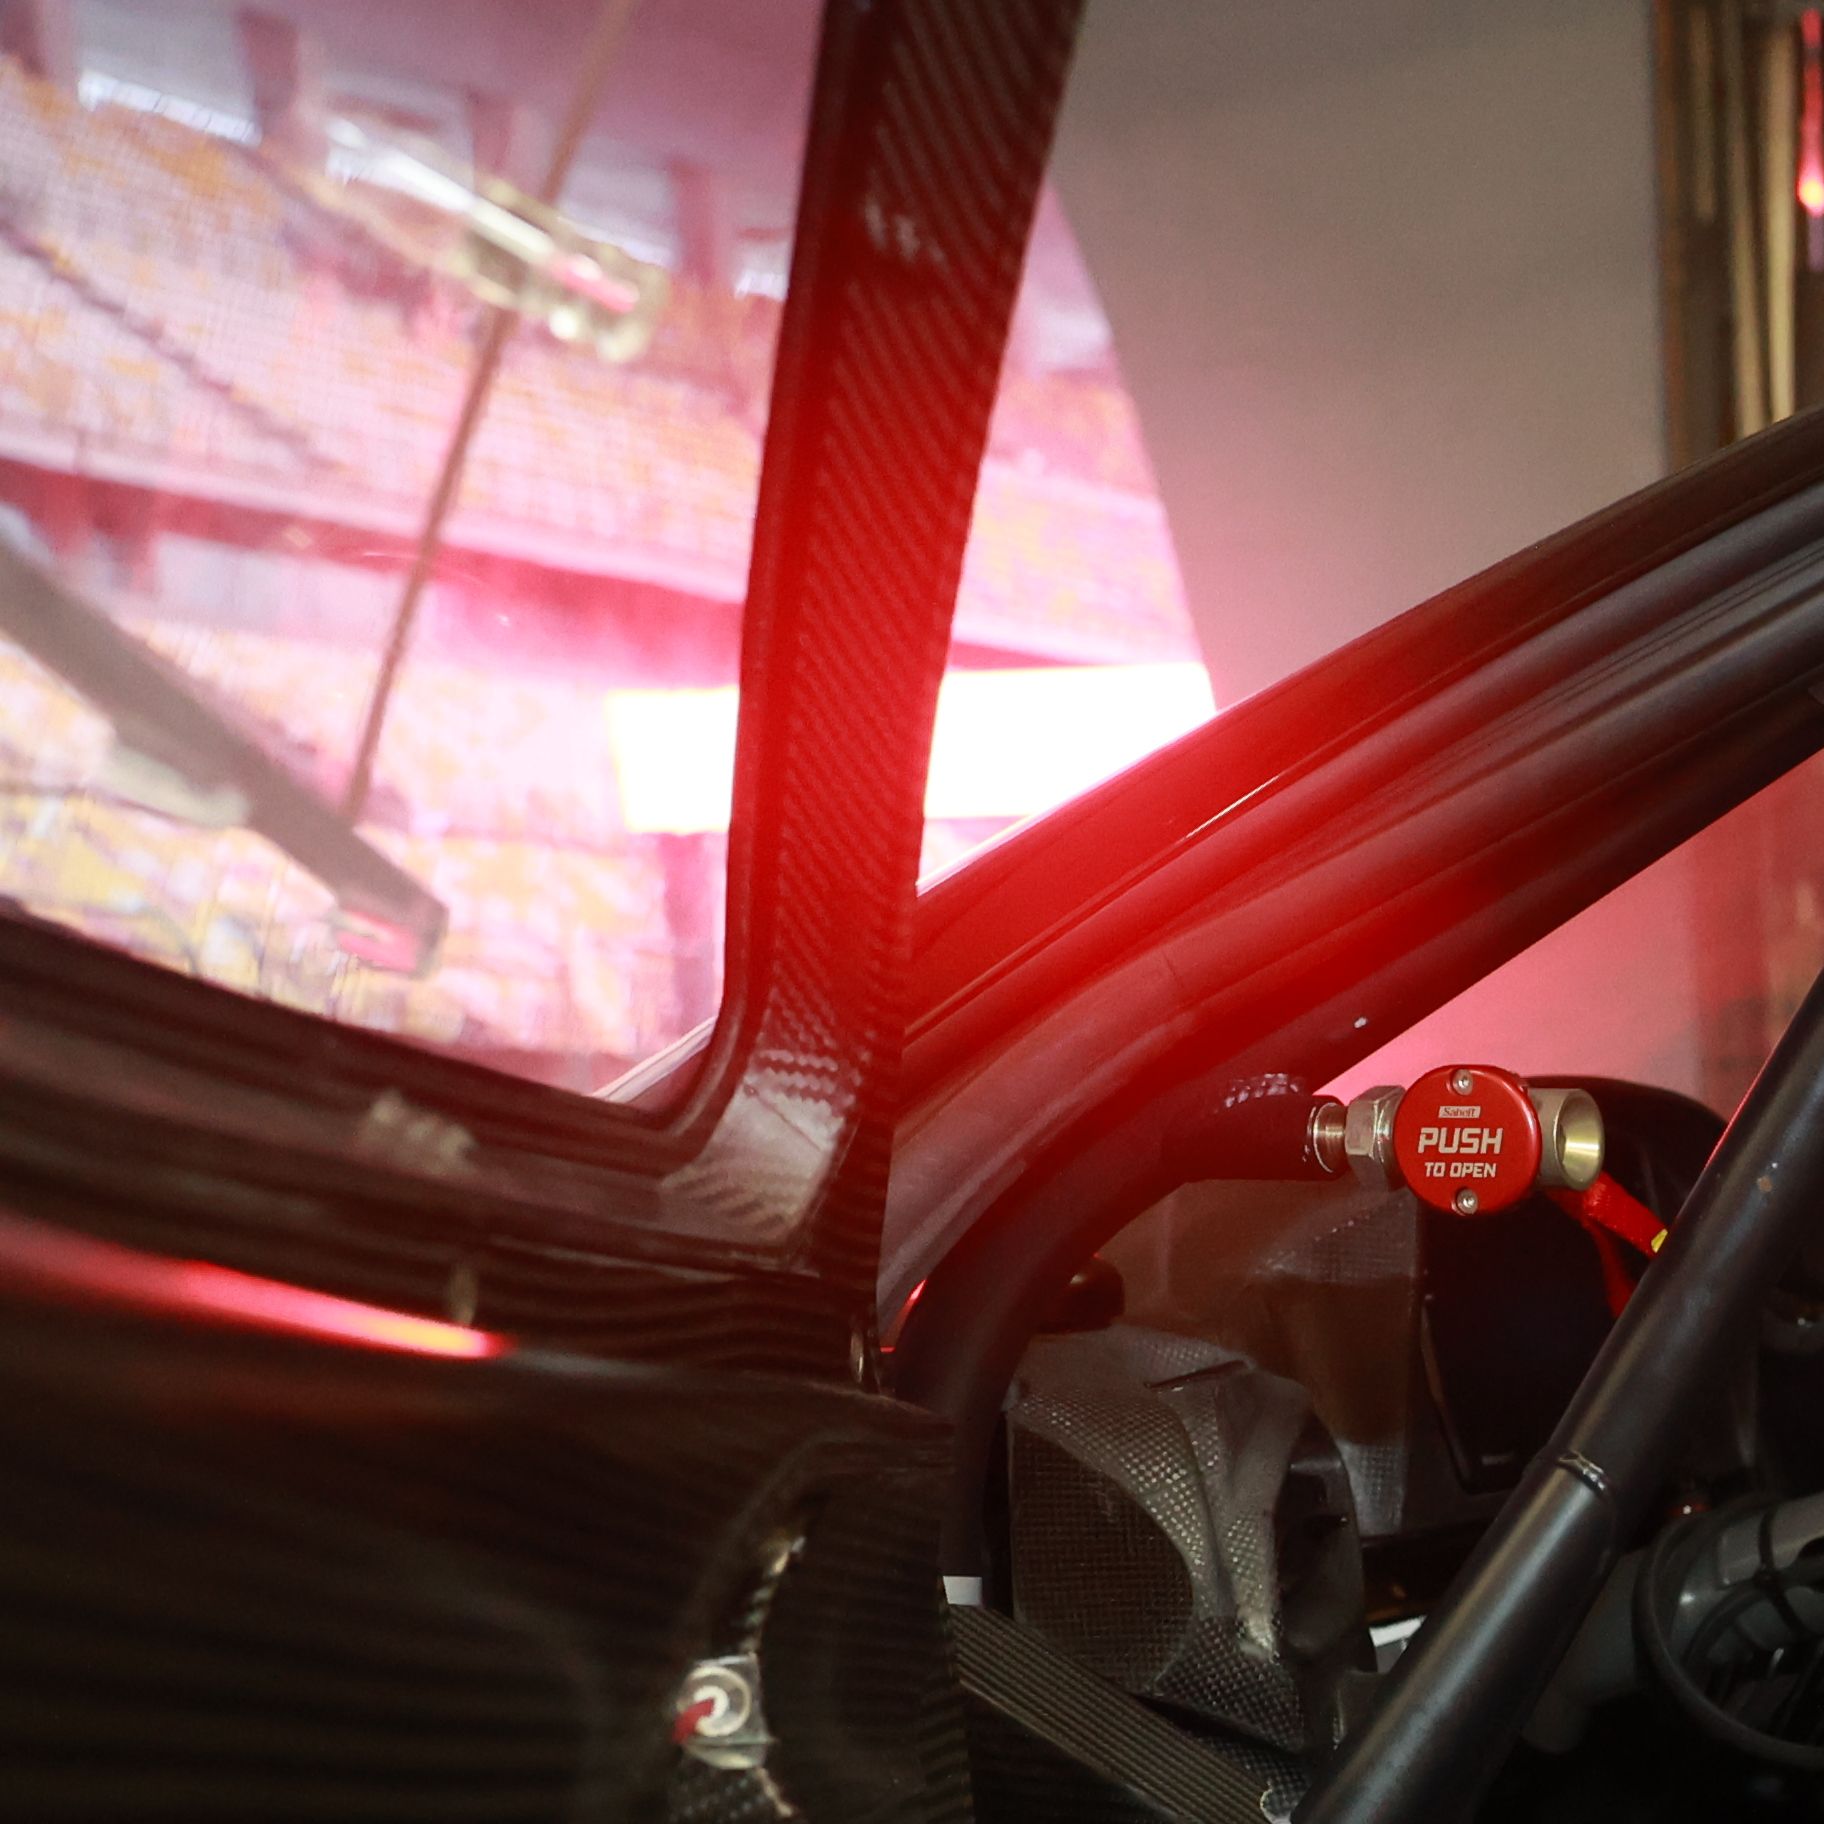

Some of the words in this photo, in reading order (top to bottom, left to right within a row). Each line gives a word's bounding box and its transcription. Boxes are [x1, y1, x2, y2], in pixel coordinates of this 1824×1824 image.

[1417, 1127, 1503, 1154] PUSH
[1424, 1162, 1446, 1177] TO
[1449, 1162, 1497, 1178] OPEN
